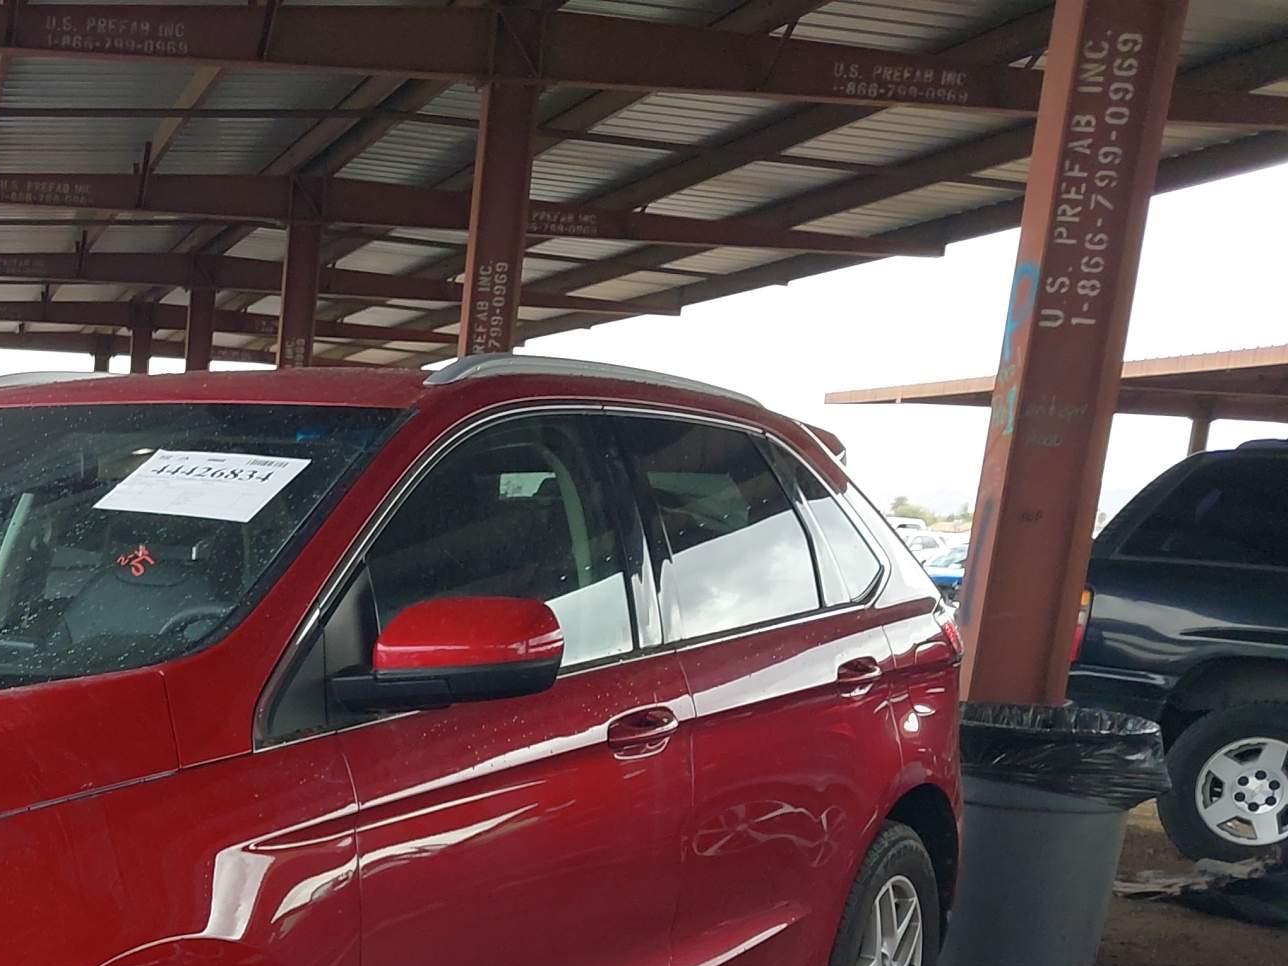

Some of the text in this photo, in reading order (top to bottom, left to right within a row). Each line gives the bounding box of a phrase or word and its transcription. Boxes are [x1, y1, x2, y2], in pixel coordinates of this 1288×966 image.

[86, 17, 150, 35] PREFAB
[872, 65, 934, 83] PREFAB
[1054, 114, 1097, 245] PREFAB
[1070, 33, 1143, 326] 1-866-799-0969
[471, 302, 489, 355] REFAB
[152, 464, 274, 482] 44426834
